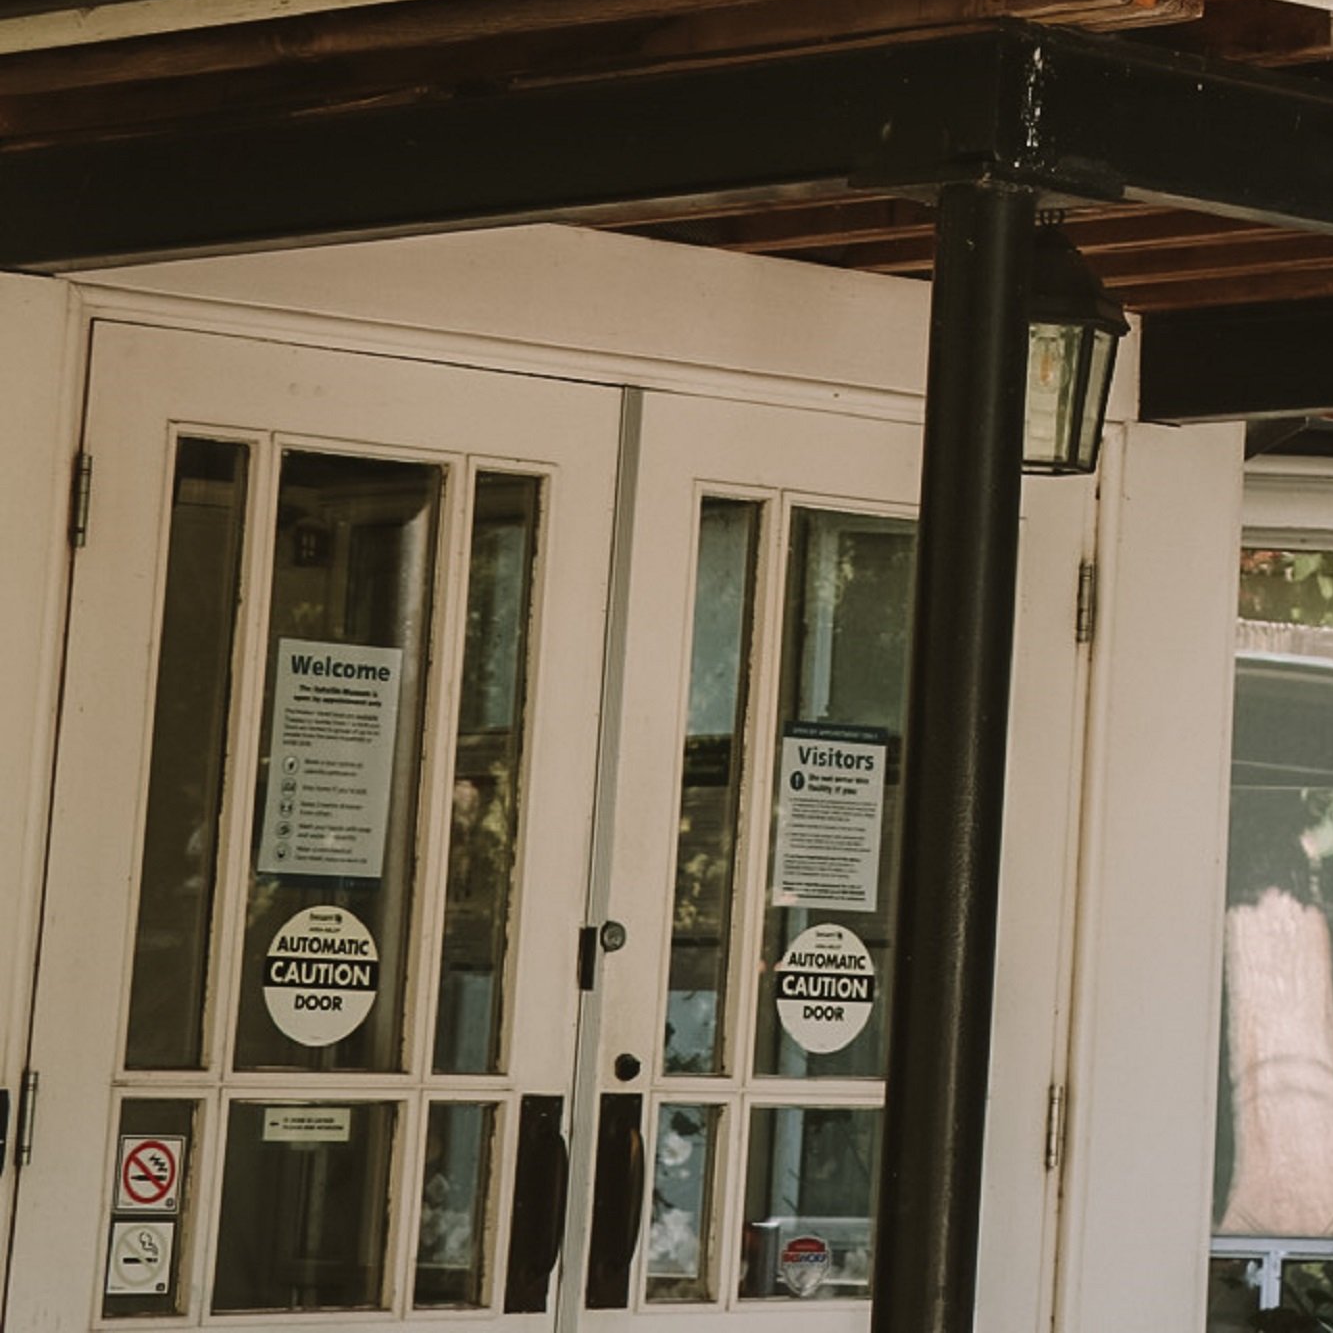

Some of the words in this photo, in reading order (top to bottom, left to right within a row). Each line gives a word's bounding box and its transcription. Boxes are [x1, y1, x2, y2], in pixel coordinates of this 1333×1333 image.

[291, 655, 391, 681] Welcome
[798, 746, 875, 771] Visitors
[277, 936, 369, 956] AUTOMATIC
[788, 952, 867, 970] AUTOMATIC
[270, 961, 371, 986] CAUTION
[782, 975, 868, 999] CAUTION
[294, 994, 343, 1011] DOOR
[803, 1005, 844, 1021] DOOR
